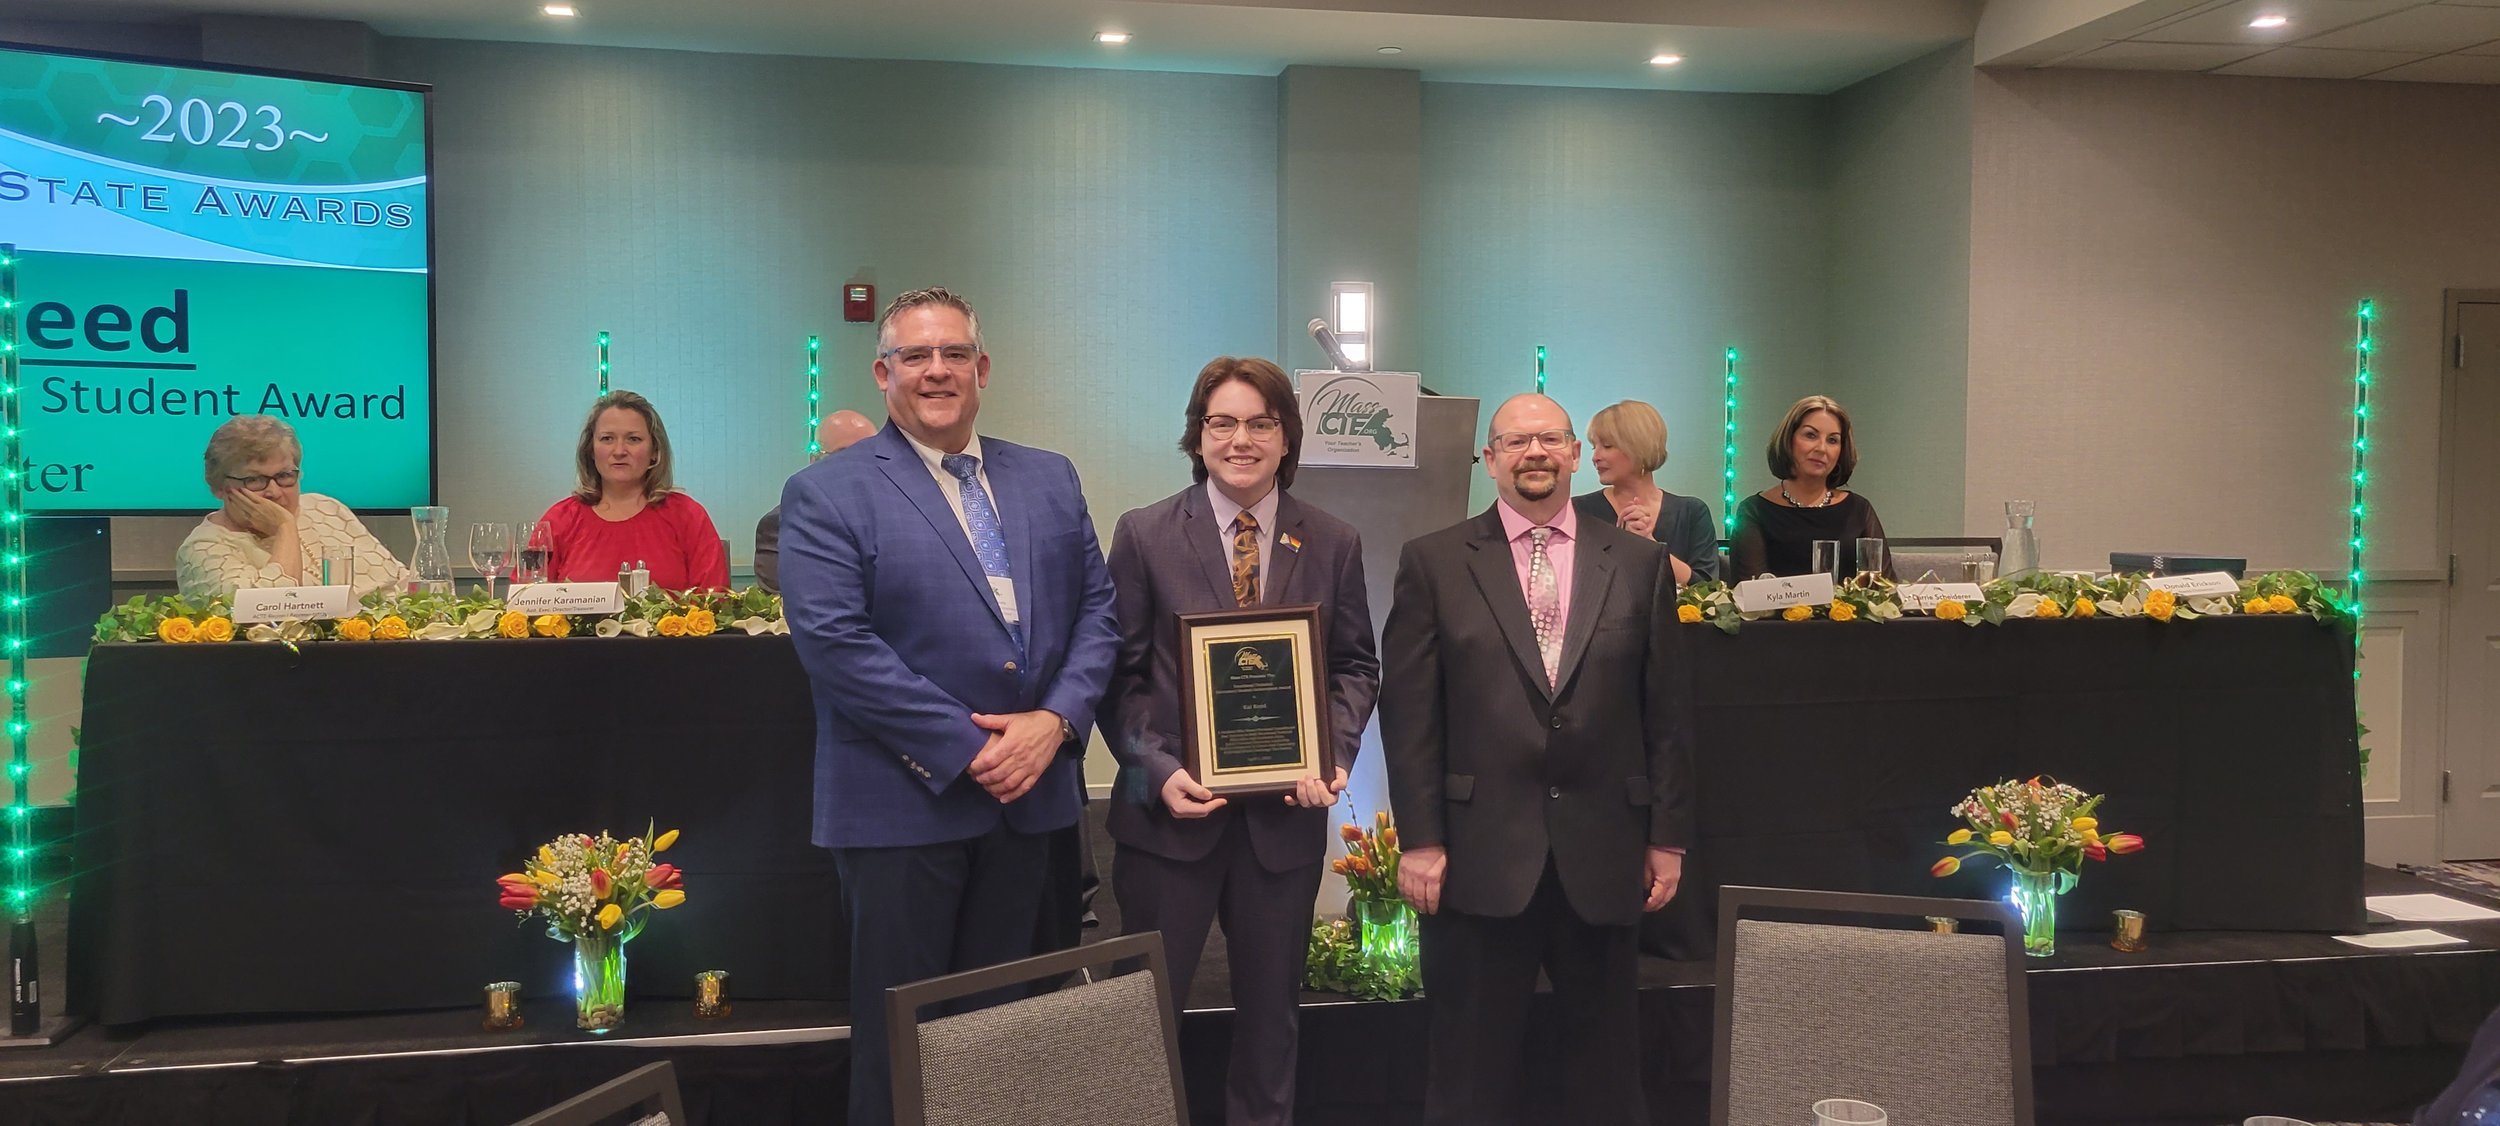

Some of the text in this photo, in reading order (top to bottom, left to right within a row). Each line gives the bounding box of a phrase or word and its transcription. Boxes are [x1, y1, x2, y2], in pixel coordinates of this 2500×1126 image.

[0, 170, 413, 228] STATE AWARDS
[25, 289, 190, 354] eed
[41, 375, 406, 420] Student Award
[1317, 389, 1380, 413] Mass
[1320, 412, 1374, 436] CTE
[23, 456, 94, 493] ter
[1767, 590, 1810, 602] Kyla Martin
[2191, 580, 2222, 588] Erickson
[256, 602, 324, 611] Carol Hartnett
[515, 595, 606, 605] Jennifer Karamanian
